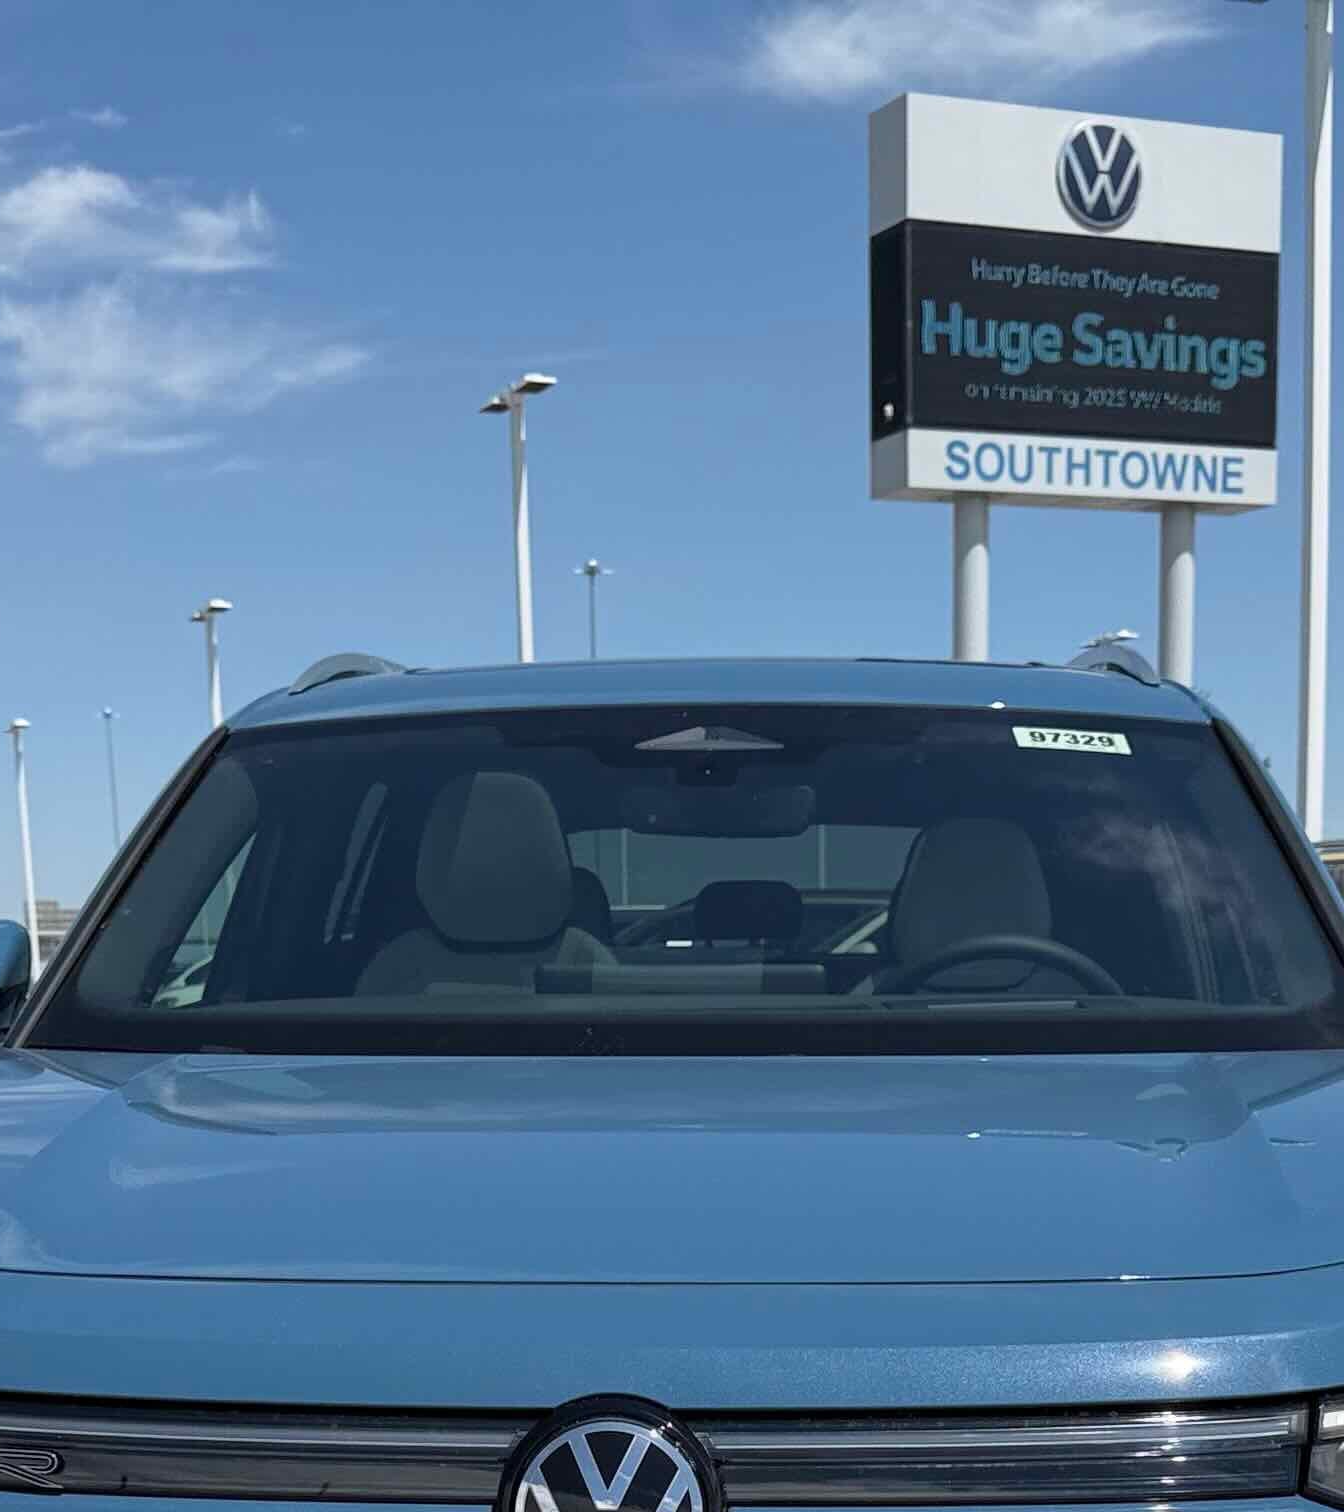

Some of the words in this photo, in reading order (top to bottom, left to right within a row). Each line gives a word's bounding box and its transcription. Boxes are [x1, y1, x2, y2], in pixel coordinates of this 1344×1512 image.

[1058, 122, 1142, 228] VW
[1027, 262, 1089, 289] Before
[1090, 267, 1136, 298] They
[1137, 273, 1169, 296] Are
[1170, 275, 1220, 300] Gone
[920, 297, 1064, 375] Huge
[1072, 311, 1266, 390] Savings
[944, 439, 1245, 495] SOUTHTOWNE
[1029, 730, 1115, 748] 97329
